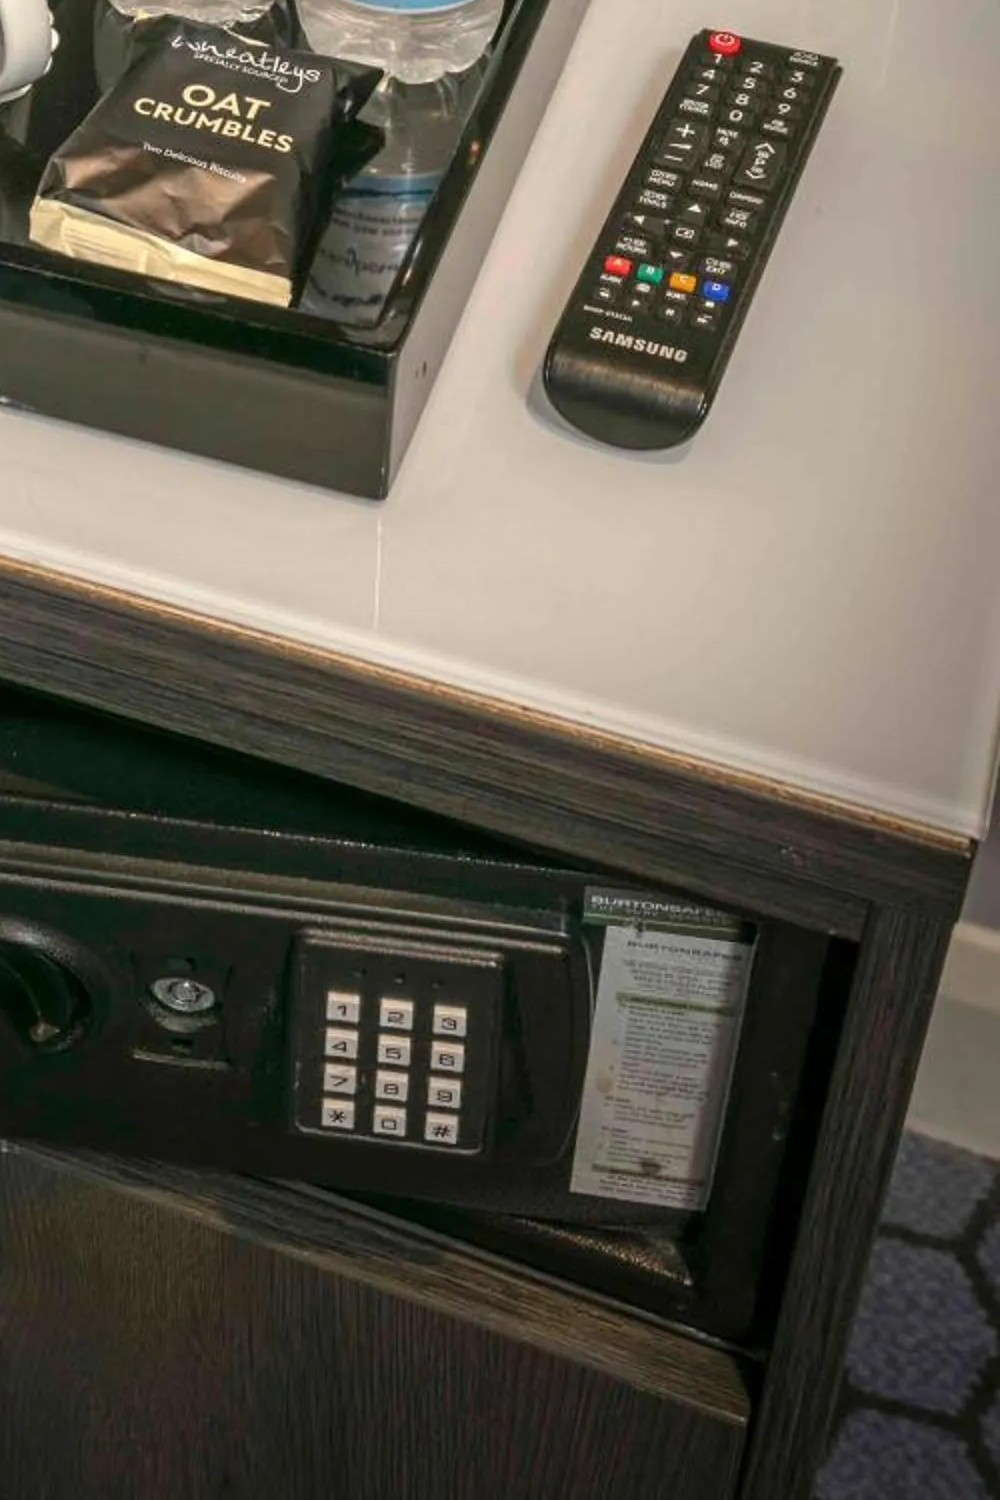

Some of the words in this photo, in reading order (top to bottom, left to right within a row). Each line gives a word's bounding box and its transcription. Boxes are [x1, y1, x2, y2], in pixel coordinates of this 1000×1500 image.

[714, 53, 723, 64] 1
[750, 61, 764, 75] 2
[702, 69, 716, 80] 4
[791, 71, 805, 83] 3
[696, 83, 710, 95] 7
[743, 77, 756, 89] 5
[783, 87, 797, 99] 6
[182, 84, 272, 120] OAT
[735, 93, 750, 106] 8
[778, 103, 791, 115] 9
[729, 109, 743, 122] 0
[133, 97, 294, 154] CRUMBLES
[142, 141, 162, 155] Two
[163, 147, 207, 169] Delicious
[208, 161, 248, 184] Biscuits
[589, 326, 688, 363] SAMSUNG
[337, 1005, 347, 1017] 1
[387, 1011, 404, 1023] 2
[441, 1017, 457, 1031] 3
[332, 1041, 347, 1052] 4
[385, 1047, 401, 1060] 5
[439, 1054, 455, 1066] 6
[331, 1075, 348, 1087] 7
[383, 1083, 399, 1095] 8
[437, 1090, 453, 1102] 9
